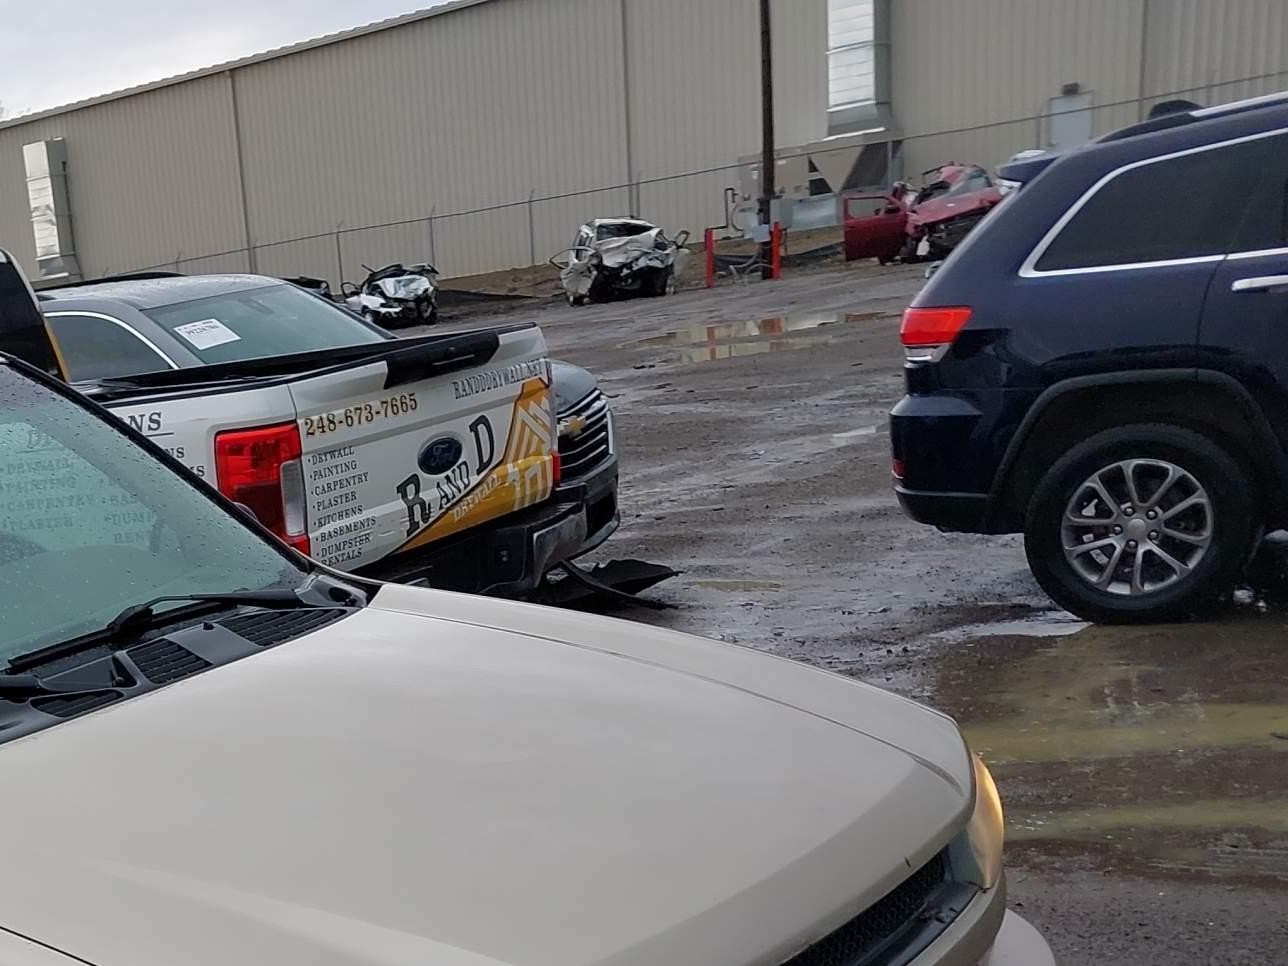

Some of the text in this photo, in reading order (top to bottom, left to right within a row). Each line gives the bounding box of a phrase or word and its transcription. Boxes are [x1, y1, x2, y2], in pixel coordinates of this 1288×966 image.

[304, 392, 418, 436] 248-673-7665
[311, 446, 355, 466] DRYWALL
[312, 460, 358, 481] PAINTING
[396, 414, 495, 538] R AND D
[314, 471, 369, 496] CARPENTRY
[316, 490, 357, 512] PLASTER
[317, 505, 363, 529] KITCHENS
[319, 516, 377, 542] BASEMENTS
[321, 533, 371, 558] DUMPSTER
